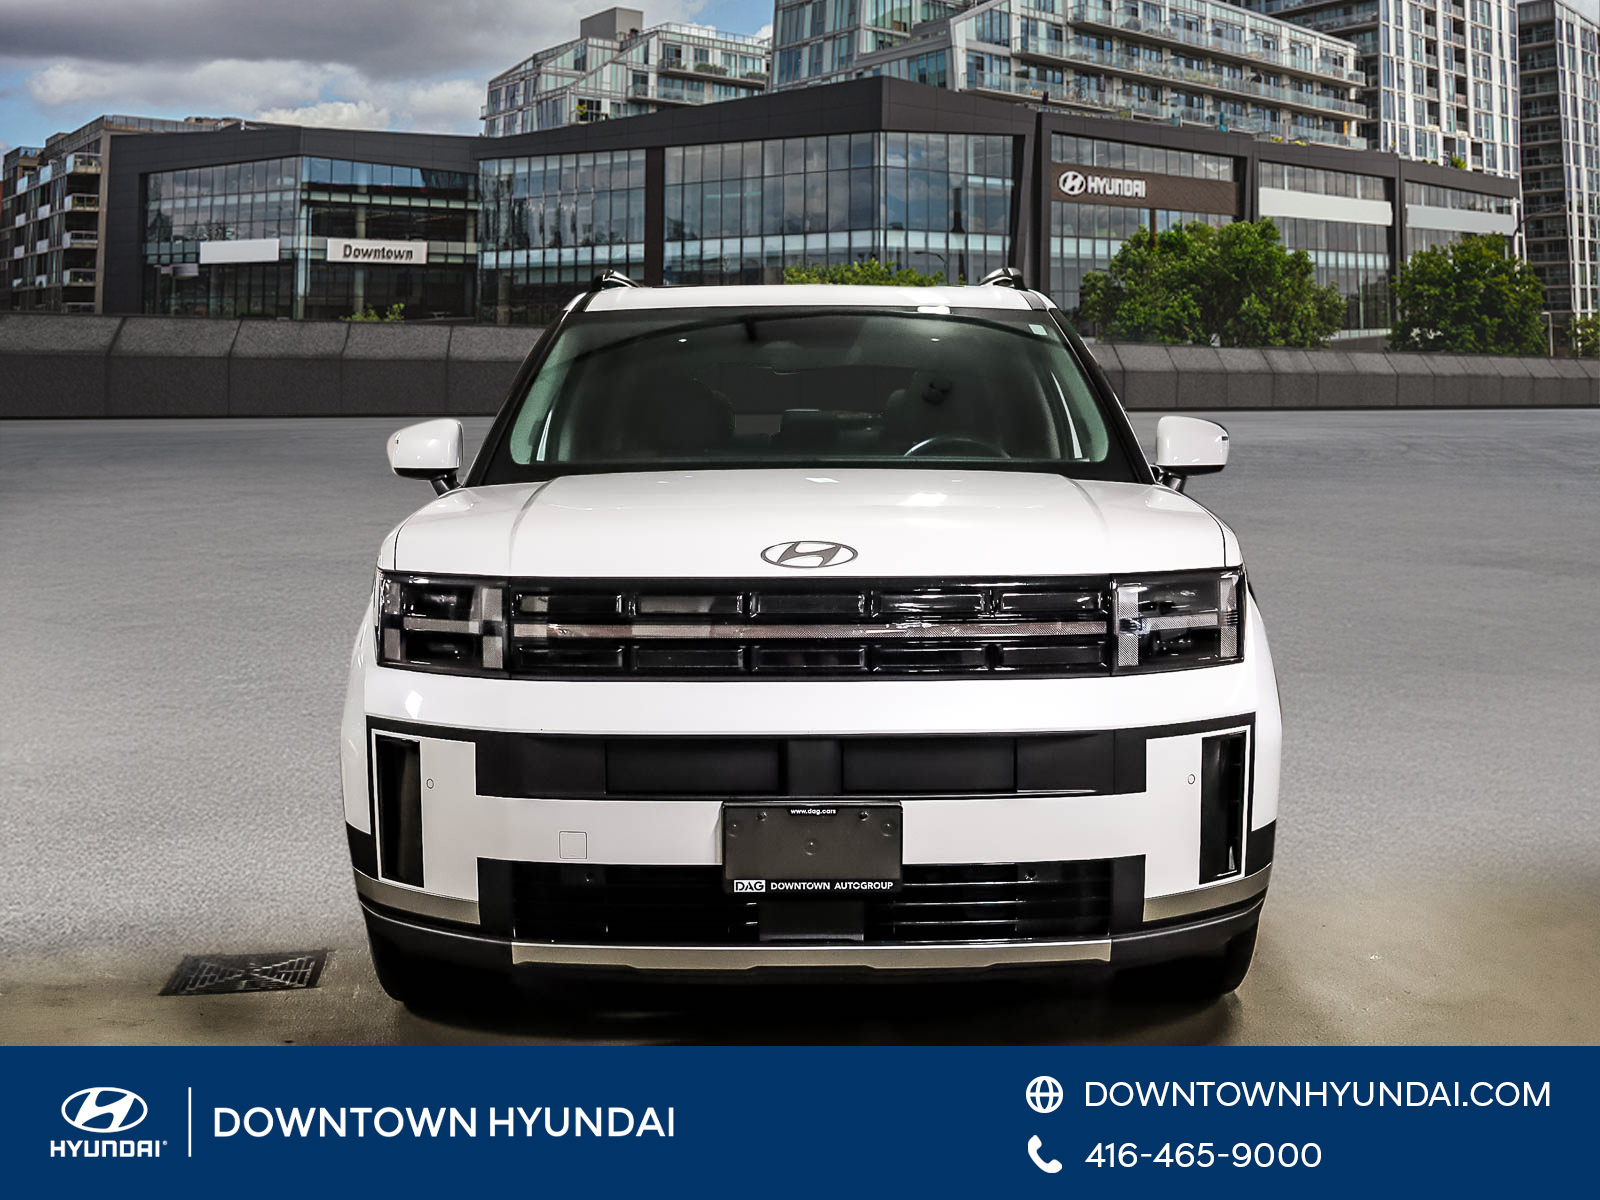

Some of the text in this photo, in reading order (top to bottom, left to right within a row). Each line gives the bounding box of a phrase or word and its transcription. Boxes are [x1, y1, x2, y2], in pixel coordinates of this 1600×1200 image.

[1087, 175, 1146, 198] HYUNDAI
[342, 244, 413, 260] Downtown
[790, 808, 837, 816] www.dag.cars
[735, 881, 894, 891] DAG DOWNTOWN AUTOGROUP
